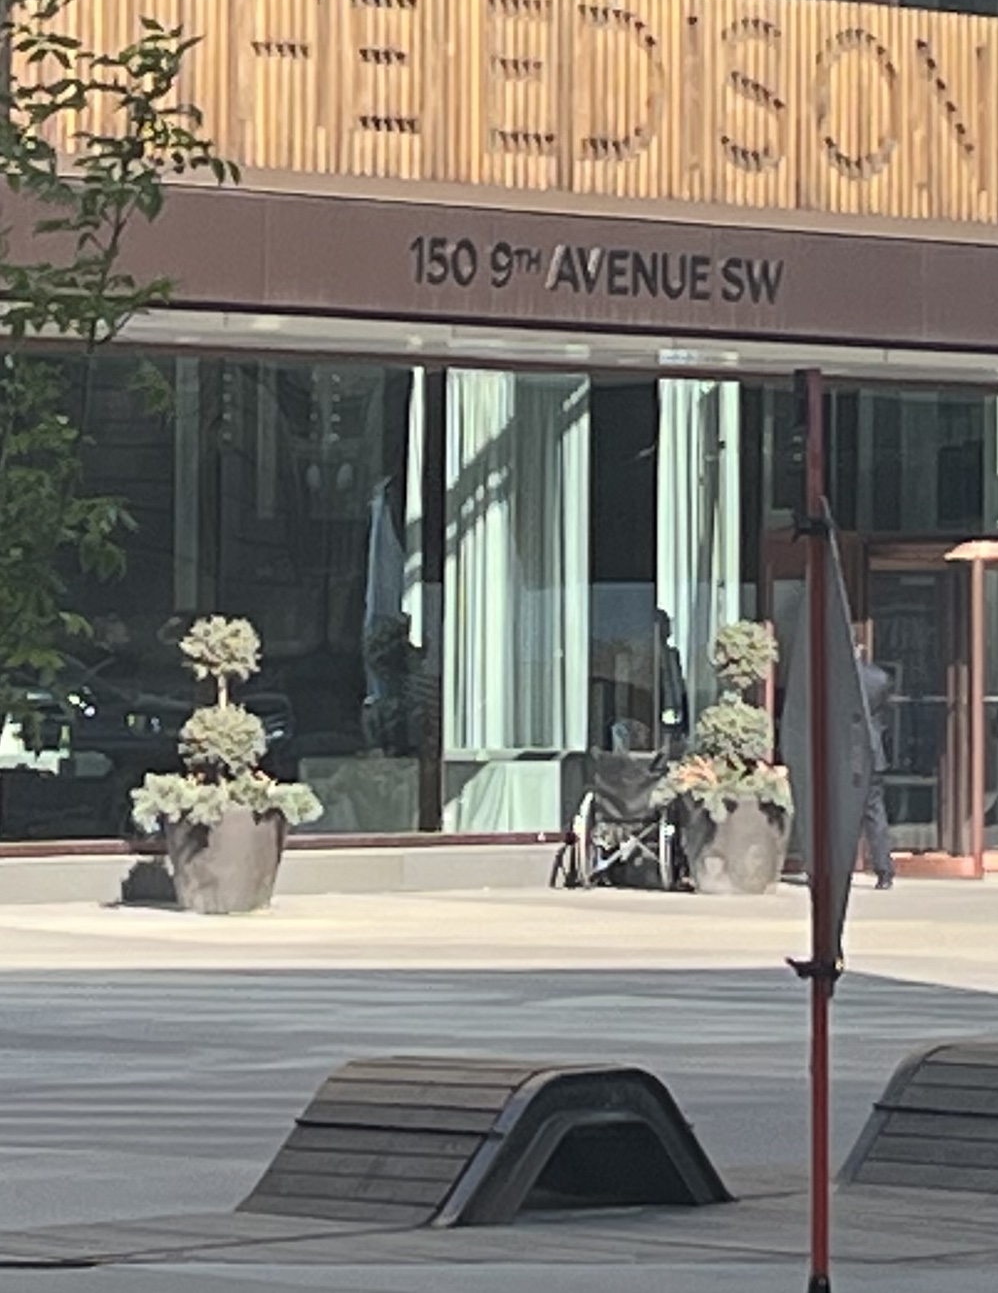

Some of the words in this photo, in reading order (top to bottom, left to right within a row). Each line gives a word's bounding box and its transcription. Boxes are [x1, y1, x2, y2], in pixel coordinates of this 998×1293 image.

[410, 235, 478, 287] 150
[490, 241, 542, 288] 9TH
[546, 244, 711, 300] AVENUE
[721, 256, 785, 305] SW
